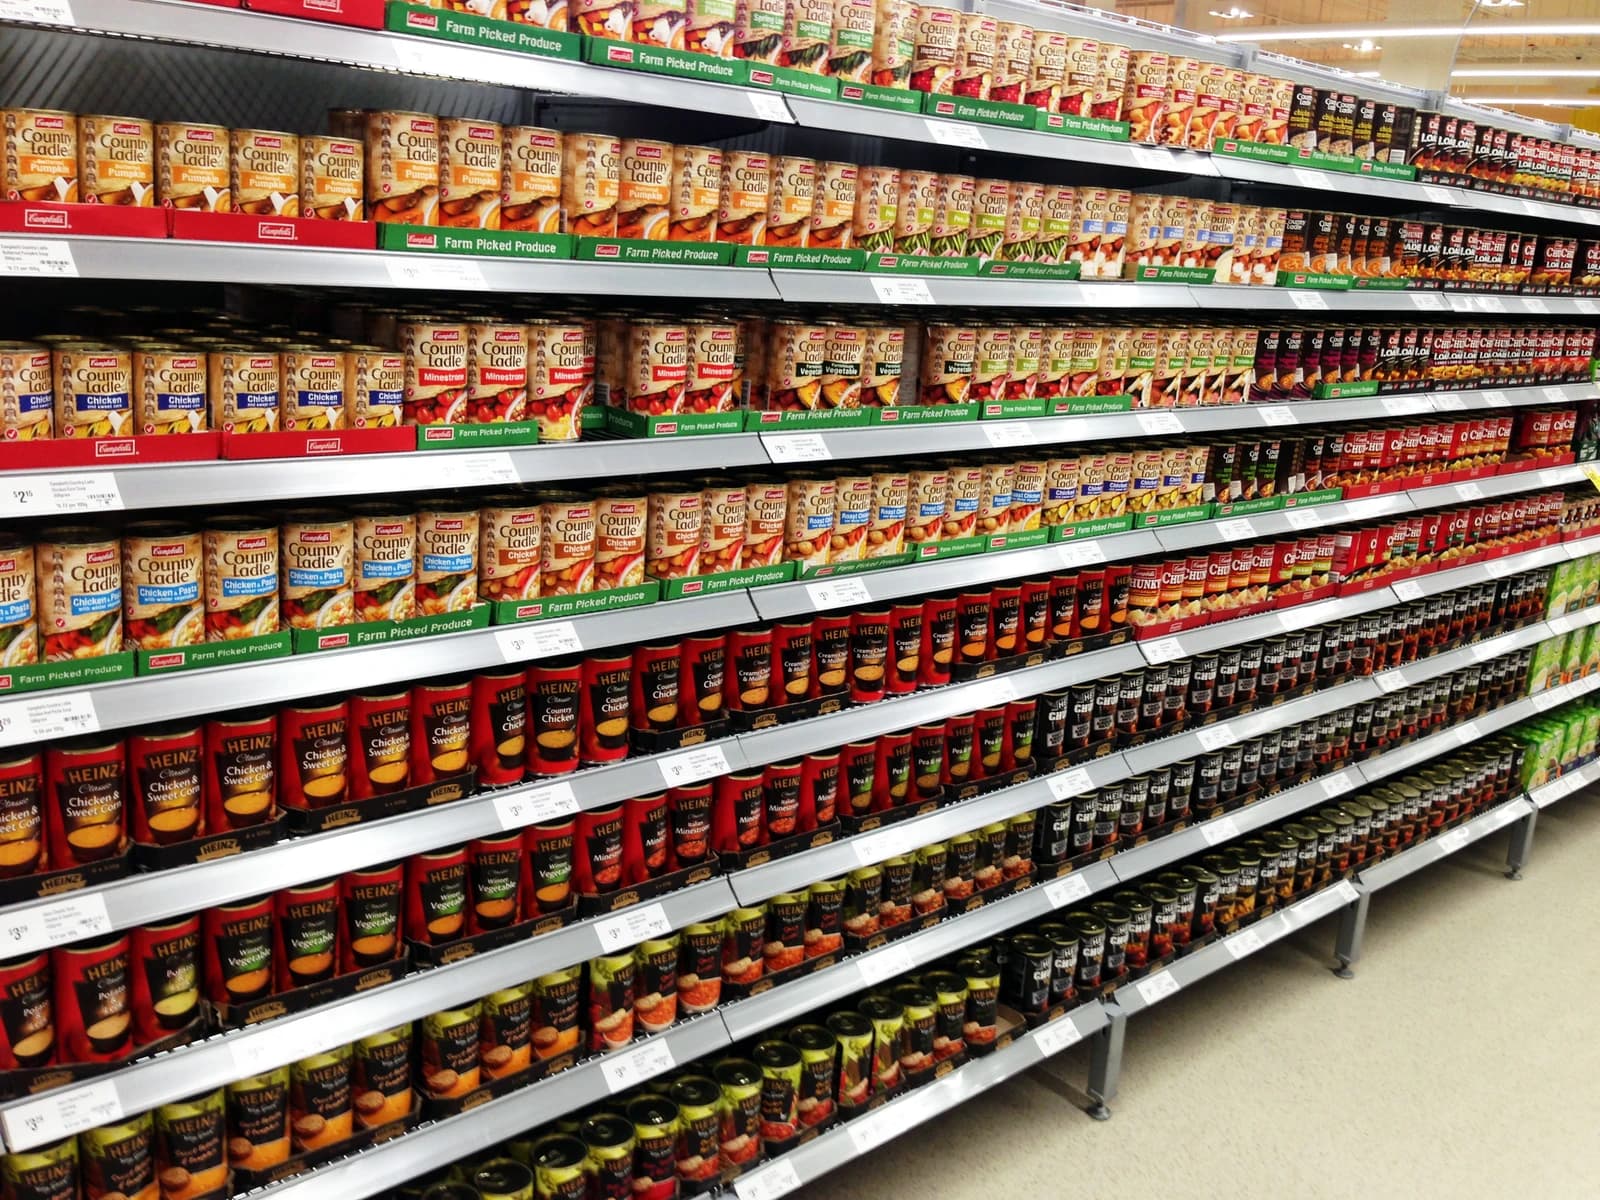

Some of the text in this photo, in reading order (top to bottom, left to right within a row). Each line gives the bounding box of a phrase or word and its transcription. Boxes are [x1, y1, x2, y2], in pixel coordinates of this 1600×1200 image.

[446, 20, 562, 51] Farm Picked Produce
[640, 53, 733, 76] Farm Picked Produce
[958, 106, 1024, 122] Farm Picked Produce
[1066, 119, 1123, 134] Farm Picked Produce
[21, 128, 72, 144] Country
[31, 144, 69, 157] Ladle
[174, 139, 223, 156] Country
[182, 155, 219, 168] Ladle
[624, 157, 667, 172] Country
[30, 164, 69, 174] Pumpkin
[108, 168, 146, 179] Pumpkin
[249, 179, 286, 189] Pumpkin
[462, 174, 497, 187] Pumpkin
[632, 170, 663, 184] Ladle
[324, 183, 357, 194] Pumpkin
[523, 180, 557, 193] Pumpkin
[629, 190, 663, 200] Pumpkin
[445, 238, 556, 253] Farm Picked Produce
[626, 247, 718, 260] Farm Picked Produce
[774, 253, 852, 264] Farm Picked Produce
[901, 259, 968, 269] Farm Picked Produce
[420, 342, 466, 356] Country
[429, 354, 462, 367] Ladle
[77, 370, 128, 384] Country
[160, 370, 204, 384] Country
[424, 372, 464, 382] Minestrone
[486, 372, 524, 382] Minestrone
[826, 366, 858, 376] Vegetable
[86, 381, 121, 393] Ladle
[168, 381, 200, 393] Ladle
[88, 396, 122, 405] Chicken
[786, 409, 862, 420] Farm Picked Produce
[903, 408, 968, 419] Farm Picked Produce
[459, 425, 530, 437] Farm Picked Produce
[601, 513, 641, 528] Country
[607, 524, 637, 536] Ladle
[289, 543, 342, 557] Country
[431, 541, 465, 554] Ladle
[606, 539, 636, 547] Chicken
[223, 551, 277, 566] Country
[370, 548, 406, 560] Ladle
[138, 558, 197, 573] Country
[232, 562, 271, 576] Ladle
[297, 556, 334, 568] Ladle
[149, 571, 189, 584] Ladle
[290, 572, 321, 581] Chicken
[325, 571, 343, 580] Pasta
[708, 571, 784, 589] Farm Picked Produce
[224, 579, 256, 589] Chicken
[140, 587, 173, 598] Chicken
[179, 585, 198, 594] Pasta
[549, 591, 644, 612] Farm Picked Produce
[358, 618, 472, 642] Farm Picked Produce
[860, 625, 888, 636] HEINZ
[192, 642, 282, 661] Farm Picked Produce
[20, 664, 122, 684] Farm Picked Produce
[541, 680, 578, 694] HEINZ
[542, 712, 574, 724] Chicken
[546, 706, 572, 716] Country
[306, 721, 345, 738] HEINZ
[228, 736, 272, 753] HEINZ
[150, 750, 198, 768] HEINZ
[305, 748, 339, 761] Chicken
[69, 764, 120, 783] HEINZ
[227, 761, 272, 776] Chicken &
[150, 776, 198, 792] Chicken &
[224, 769, 273, 785] Sweet Corn
[69, 791, 120, 808] Chicken &
[147, 784, 200, 803] Sweet Corn
[67, 800, 122, 817] Sweet Corn
[680, 797, 710, 810] HEINZ
[676, 824, 710, 835] Minestrone
[201, 840, 236, 854] HEINZ
[479, 852, 518, 866] HEINZ
[356, 884, 397, 900] HEINZ
[478, 880, 517, 894] Vegetable
[291, 901, 336, 918] HEINZ
[227, 916, 271, 937] HEINZ
[354, 914, 397, 930] Vegetable
[291, 932, 335, 948] Vegetable
[228, 950, 271, 967] Vegetable
